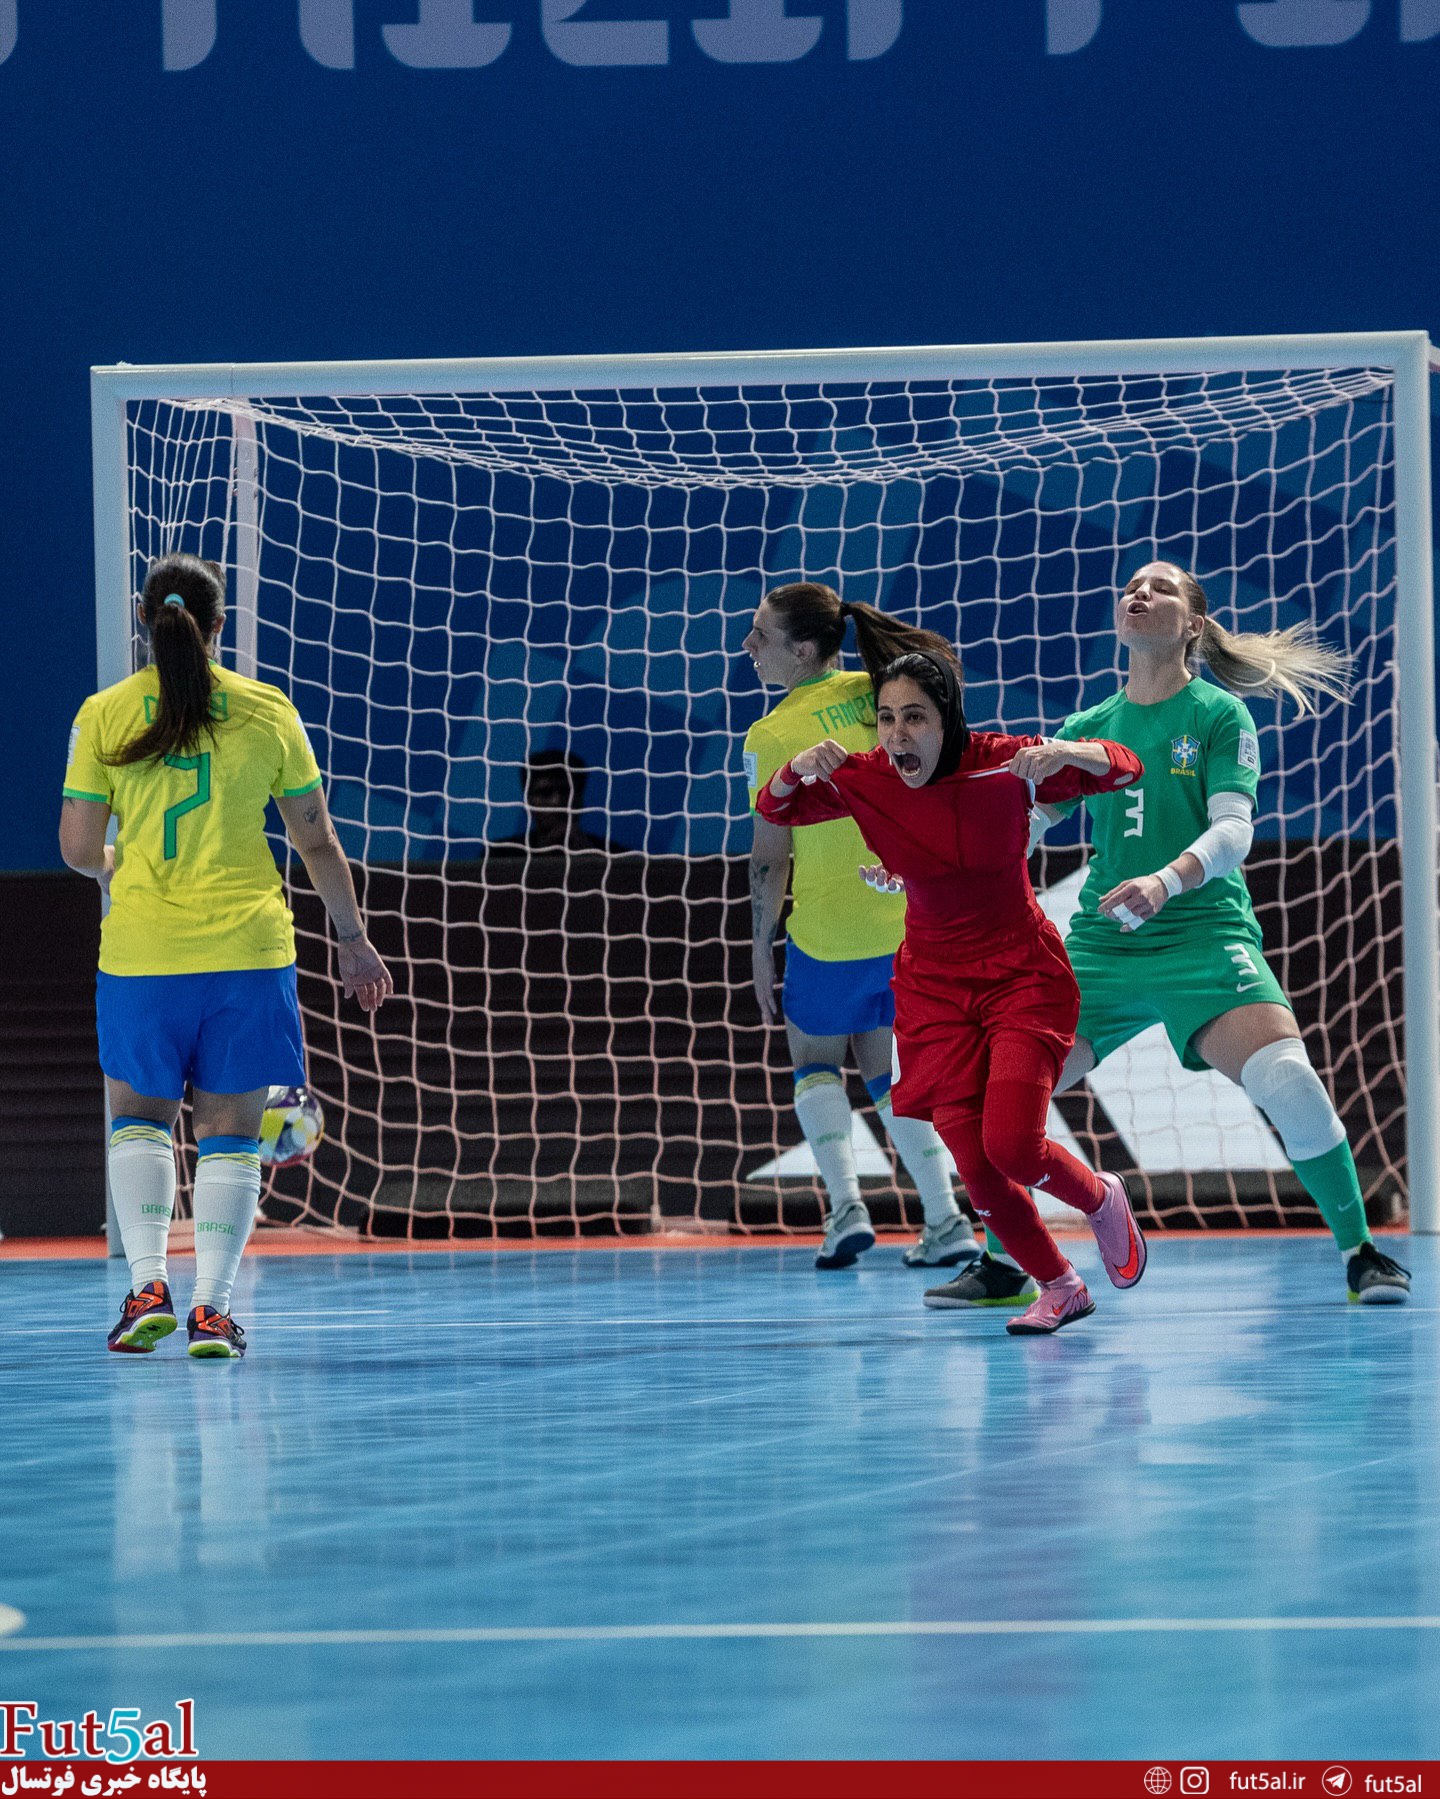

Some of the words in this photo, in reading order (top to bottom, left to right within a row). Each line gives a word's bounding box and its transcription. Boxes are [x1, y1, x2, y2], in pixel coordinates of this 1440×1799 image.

[1170, 767, 1196, 777] BRASIL
[164, 752, 210, 861] 7
[1123, 788, 1144, 838] 3
[1224, 943, 1259, 977] 3
[197, 1221, 238, 1237] BRASIL
